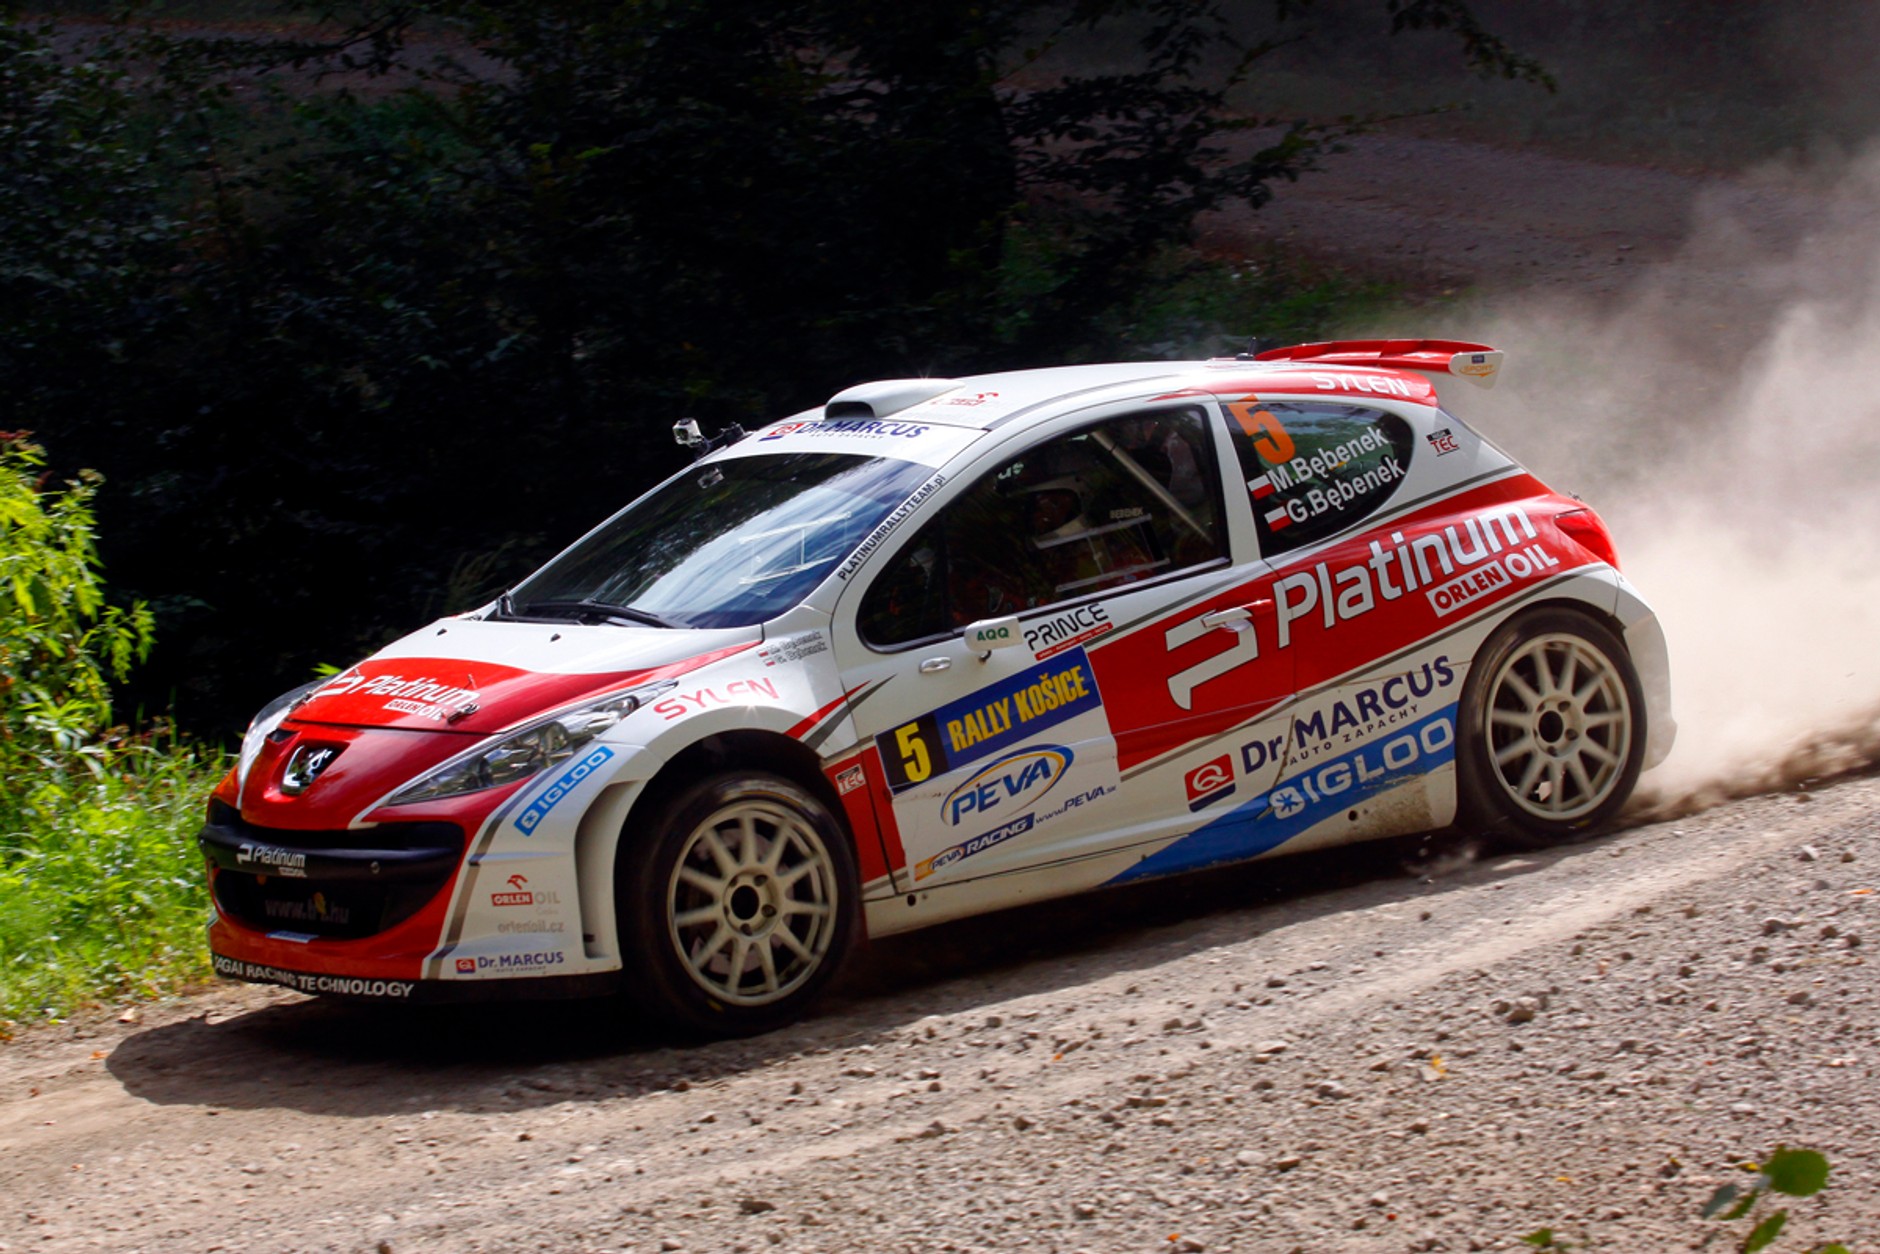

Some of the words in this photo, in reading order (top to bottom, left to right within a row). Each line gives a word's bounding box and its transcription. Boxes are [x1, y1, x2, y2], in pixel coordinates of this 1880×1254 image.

[1312, 373, 1411, 396] SYLEN
[1229, 393, 1296, 465] 5
[1430, 435, 1458, 453] TEC
[1266, 426, 1389, 493] M.Bębenek
[1287, 456, 1405, 523] G.Bębenek
[837, 474, 946, 581] PLATINUMRALLYTEAM.pl
[1272, 505, 1538, 649] Platinum
[1434, 566, 1504, 609] ORLEN
[1504, 543, 1560, 578] OIL
[976, 627, 1009, 641] AQQ
[1024, 603, 1109, 651] PRINCE
[348, 675, 480, 710] Platinum
[946, 696, 1012, 752] RALLY
[1013, 665, 1090, 722] KOŠICE
[1295, 655, 1454, 750] MARCUS
[895, 722, 932, 782] 5
[1290, 741, 1332, 766] AUTO
[1343, 704, 1419, 743] ZAPACHY
[1303, 717, 1454, 804] IGLOO
[537, 751, 608, 809] IGLOO
[840, 771, 866, 793] TEC
[952, 757, 1052, 826] PEVA
[253, 845, 306, 868] Platinum
[932, 850, 962, 870] PEVA
[966, 817, 1029, 854] RACING
[493, 895, 531, 904] ORLEN
[535, 891, 561, 905] OIL
[246, 965, 297, 986] RACING
[298, 975, 414, 998] TECHNOLOGY
[500, 952, 564, 967] MARCUS
